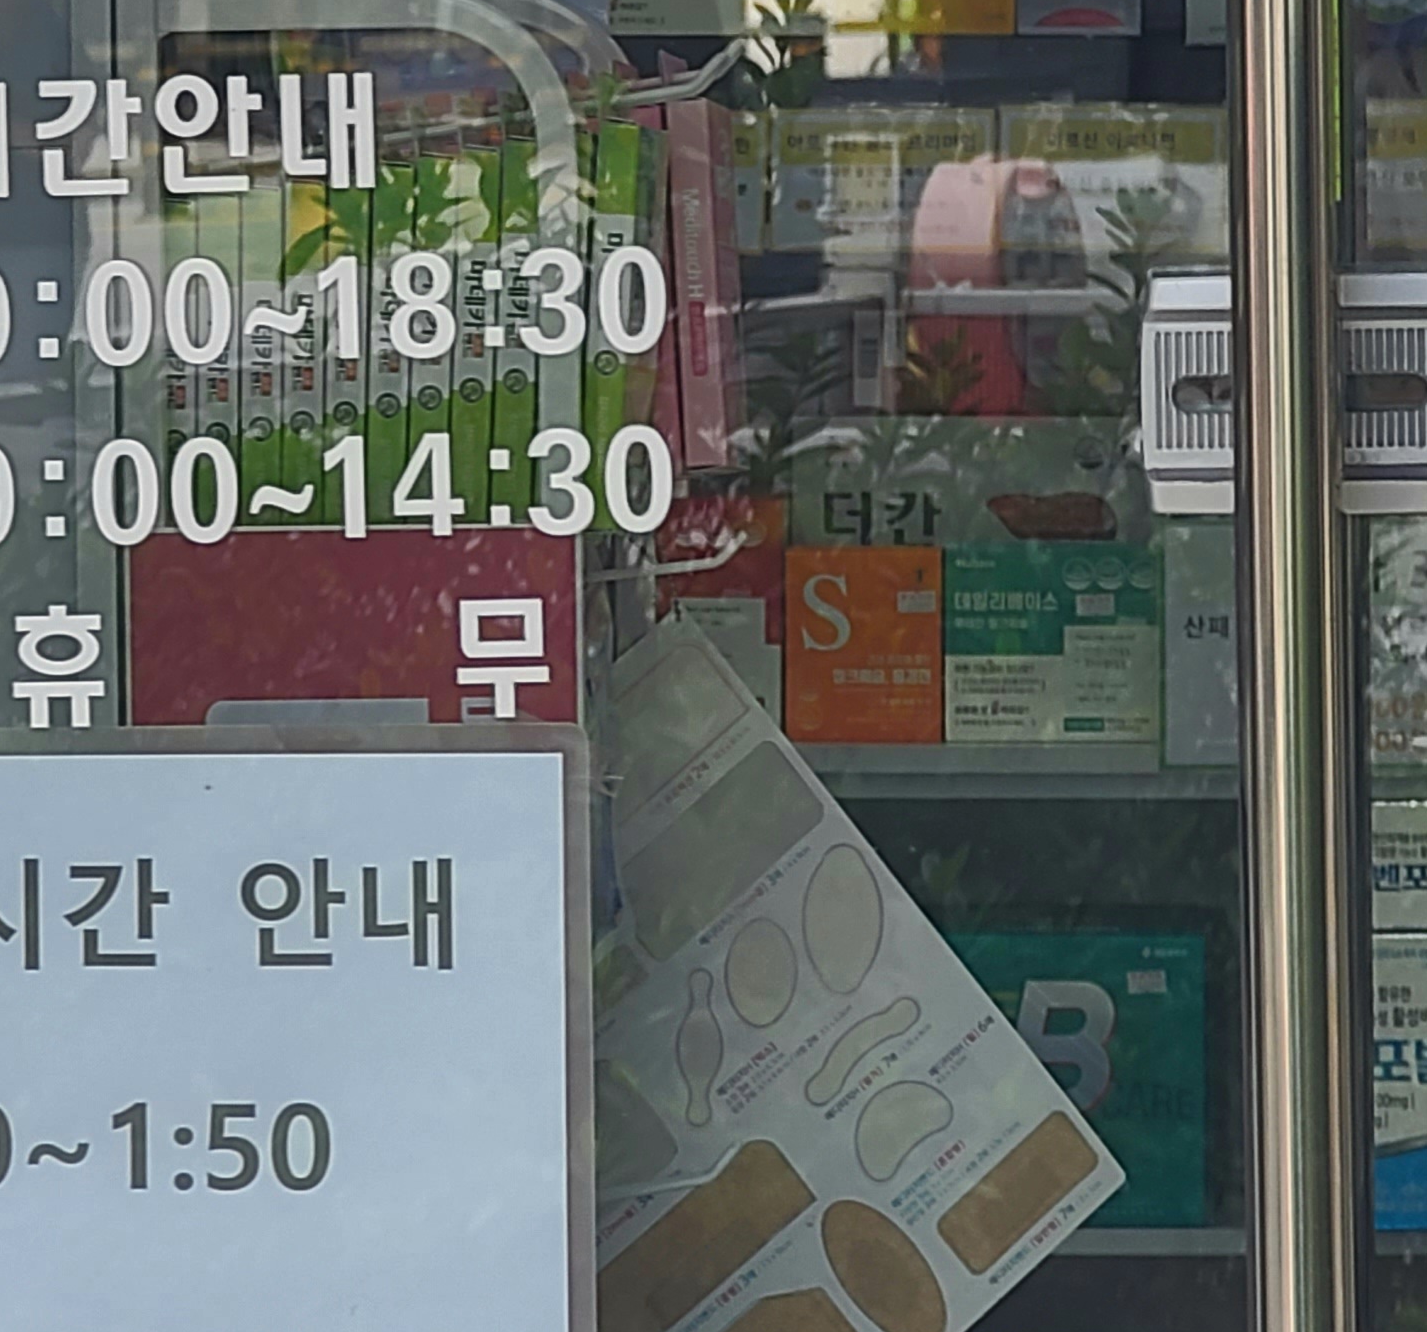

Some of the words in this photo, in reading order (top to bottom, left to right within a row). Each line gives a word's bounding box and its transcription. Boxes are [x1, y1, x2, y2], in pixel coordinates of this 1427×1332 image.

[12, 604, 105, 728] 휴
[456, 597, 551, 720] 무
[800, 573, 852, 653] S
[238, 856, 455, 972] 안내
